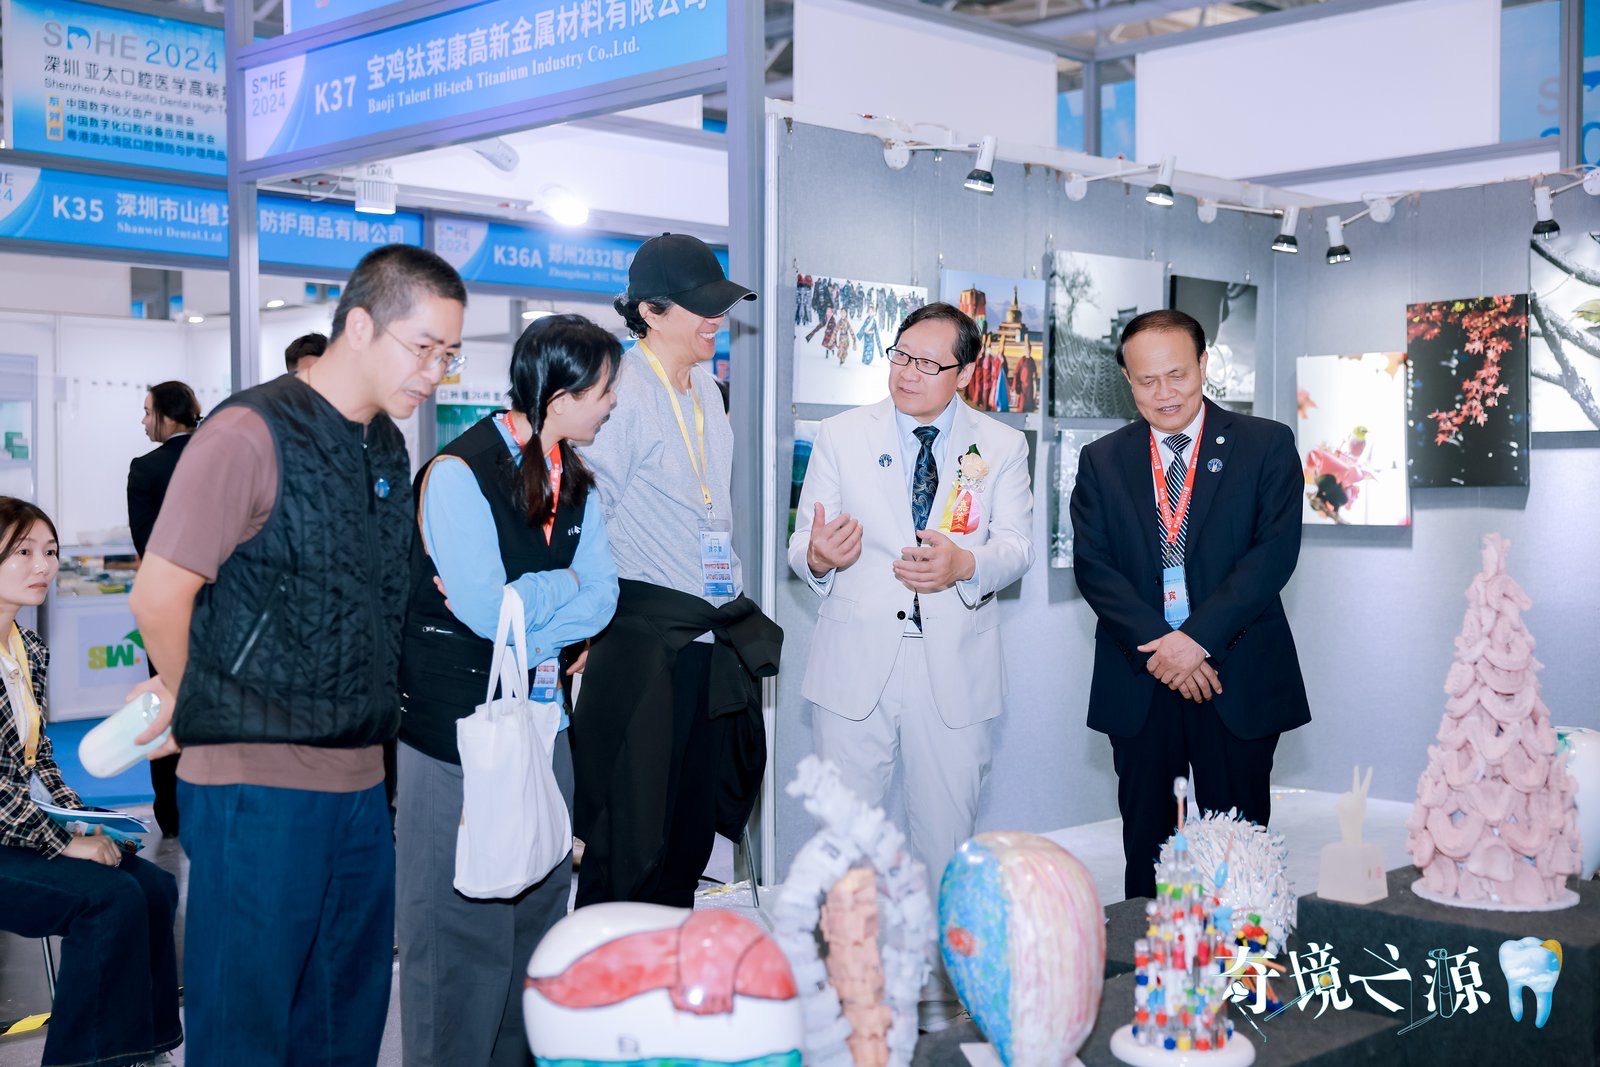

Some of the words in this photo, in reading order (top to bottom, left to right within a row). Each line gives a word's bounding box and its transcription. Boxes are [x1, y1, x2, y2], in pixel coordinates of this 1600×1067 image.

[145, 40, 218, 73] 2024
[368, 96, 395, 114] Baoji
[399, 89, 431, 107] Talent
[434, 75, 473, 98] Hi-tech
[477, 65, 528, 88] Titanium
[532, 53, 584, 76] Industry
[588, 36, 640, 63] Co.,Ltd.
[44, 78, 97, 95] Shenzhen
[160, 96, 191, 110] Dental
[252, 92, 286, 117] 2024
[315, 75, 357, 115] K37
[53, 195, 104, 222] K35
[117, 222, 163, 236] Shanwei
[493, 244, 543, 269] K36A
